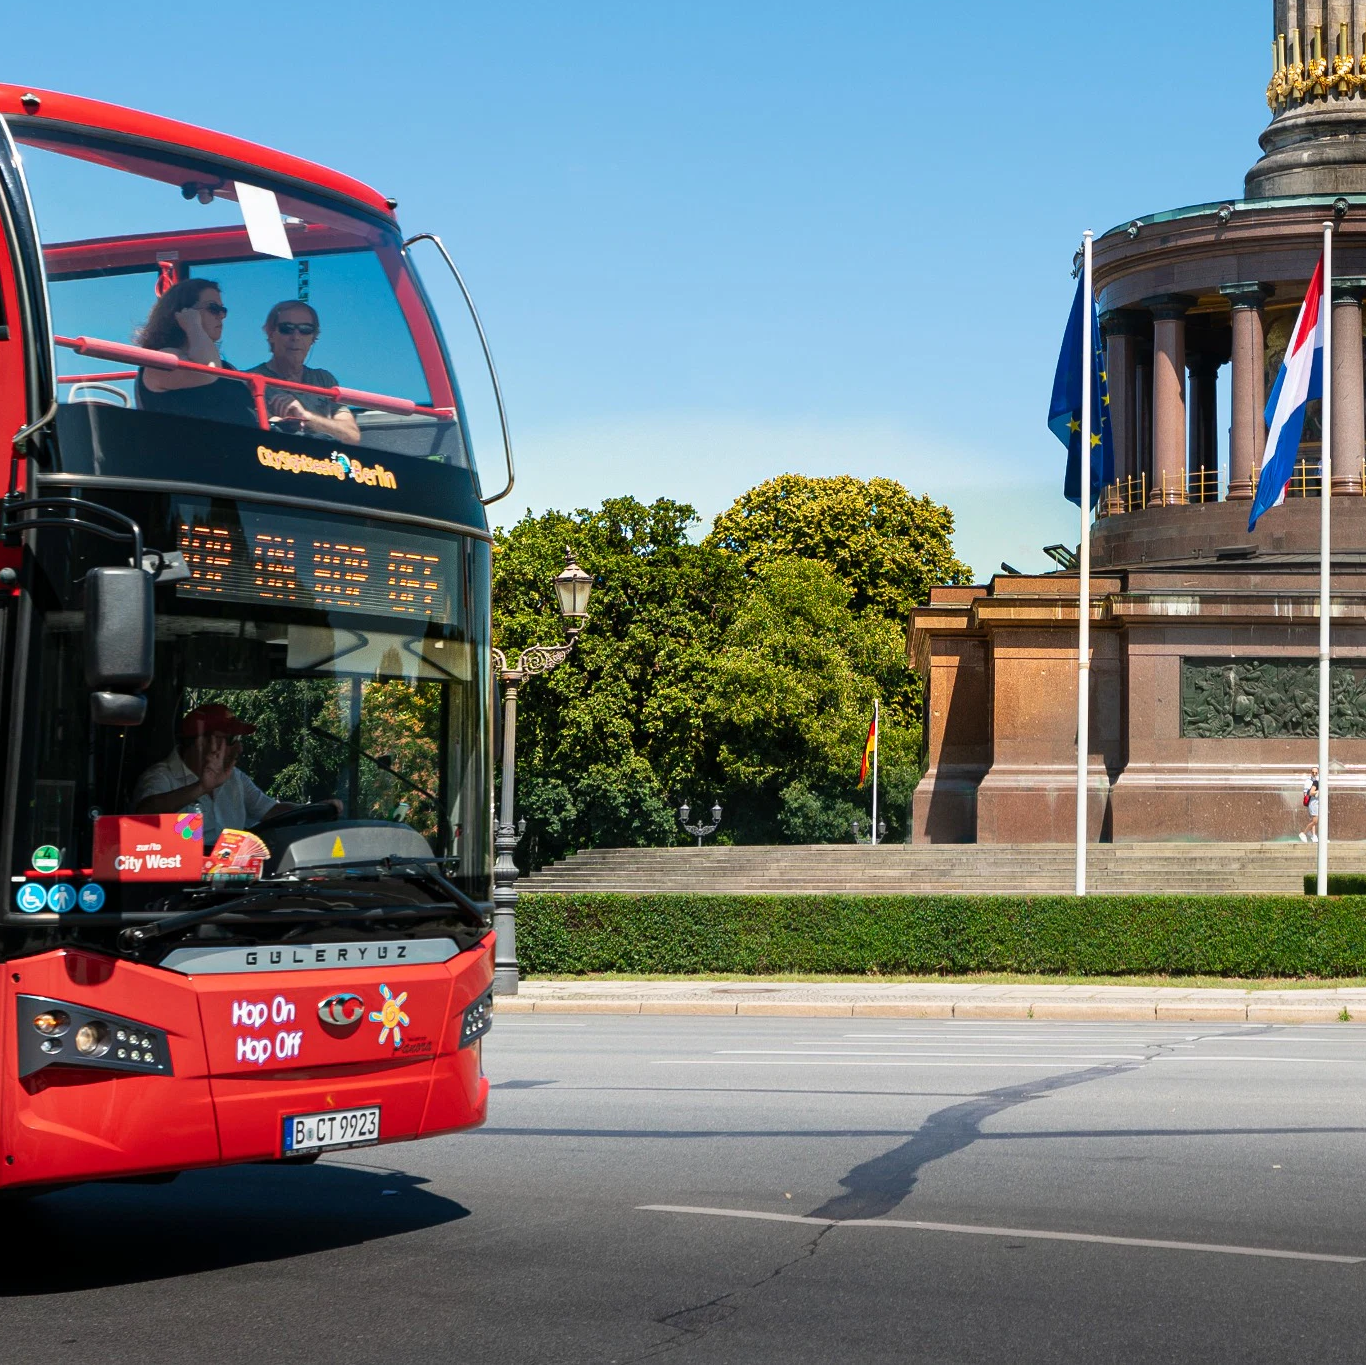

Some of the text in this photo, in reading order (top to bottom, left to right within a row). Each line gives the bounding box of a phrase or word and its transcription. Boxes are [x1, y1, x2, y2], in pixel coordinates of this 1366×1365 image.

[351, 460, 397, 489] Berlin
[43, 847, 51, 859] 4
[115, 855, 182, 873] City West
[232, 995, 296, 1029] Hop On
[237, 1031, 303, 1064] Hop Off
[295, 1111, 377, 1145] B CT 9923
